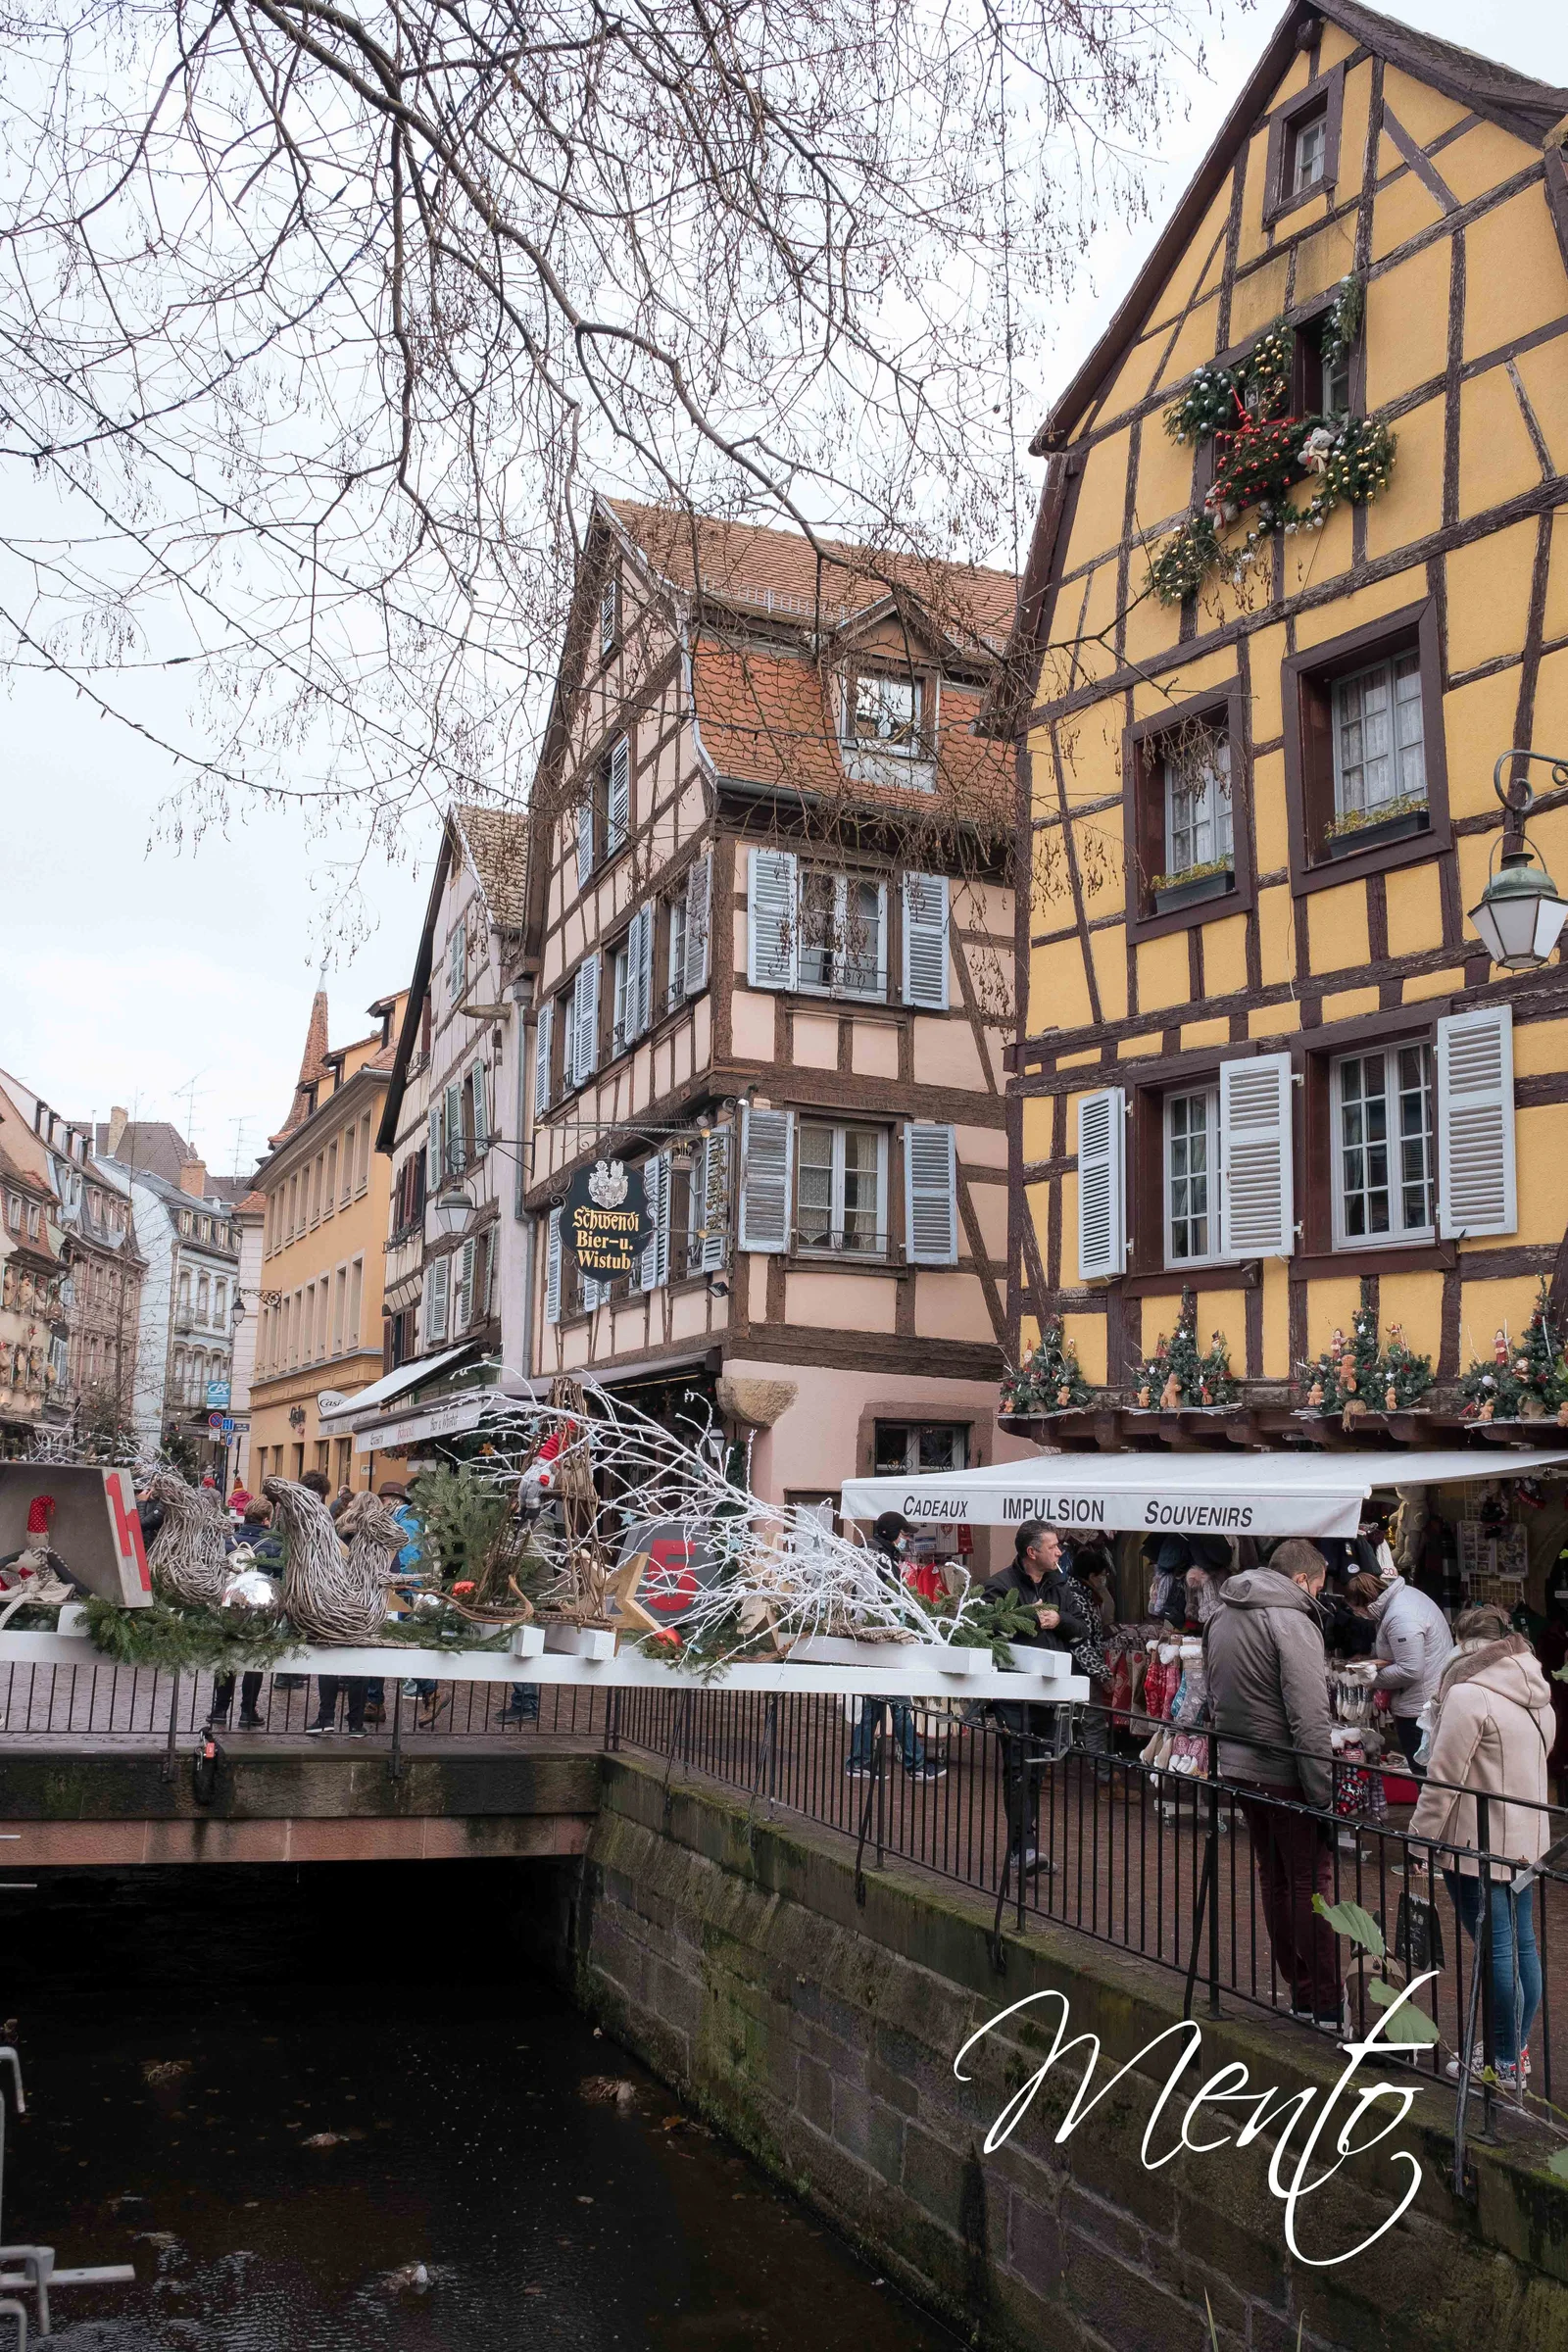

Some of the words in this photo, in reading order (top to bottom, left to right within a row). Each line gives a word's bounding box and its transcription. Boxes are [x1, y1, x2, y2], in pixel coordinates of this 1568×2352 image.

[572, 1205, 640, 1232] Schwendi
[577, 1250, 632, 1270] Wistub
[903, 1494, 968, 1518] CADEAUX
[1003, 1497, 1104, 1522] IMPULSION
[1144, 1499, 1253, 1528] SOUVENIRS
[644, 1539, 697, 1611] 5
